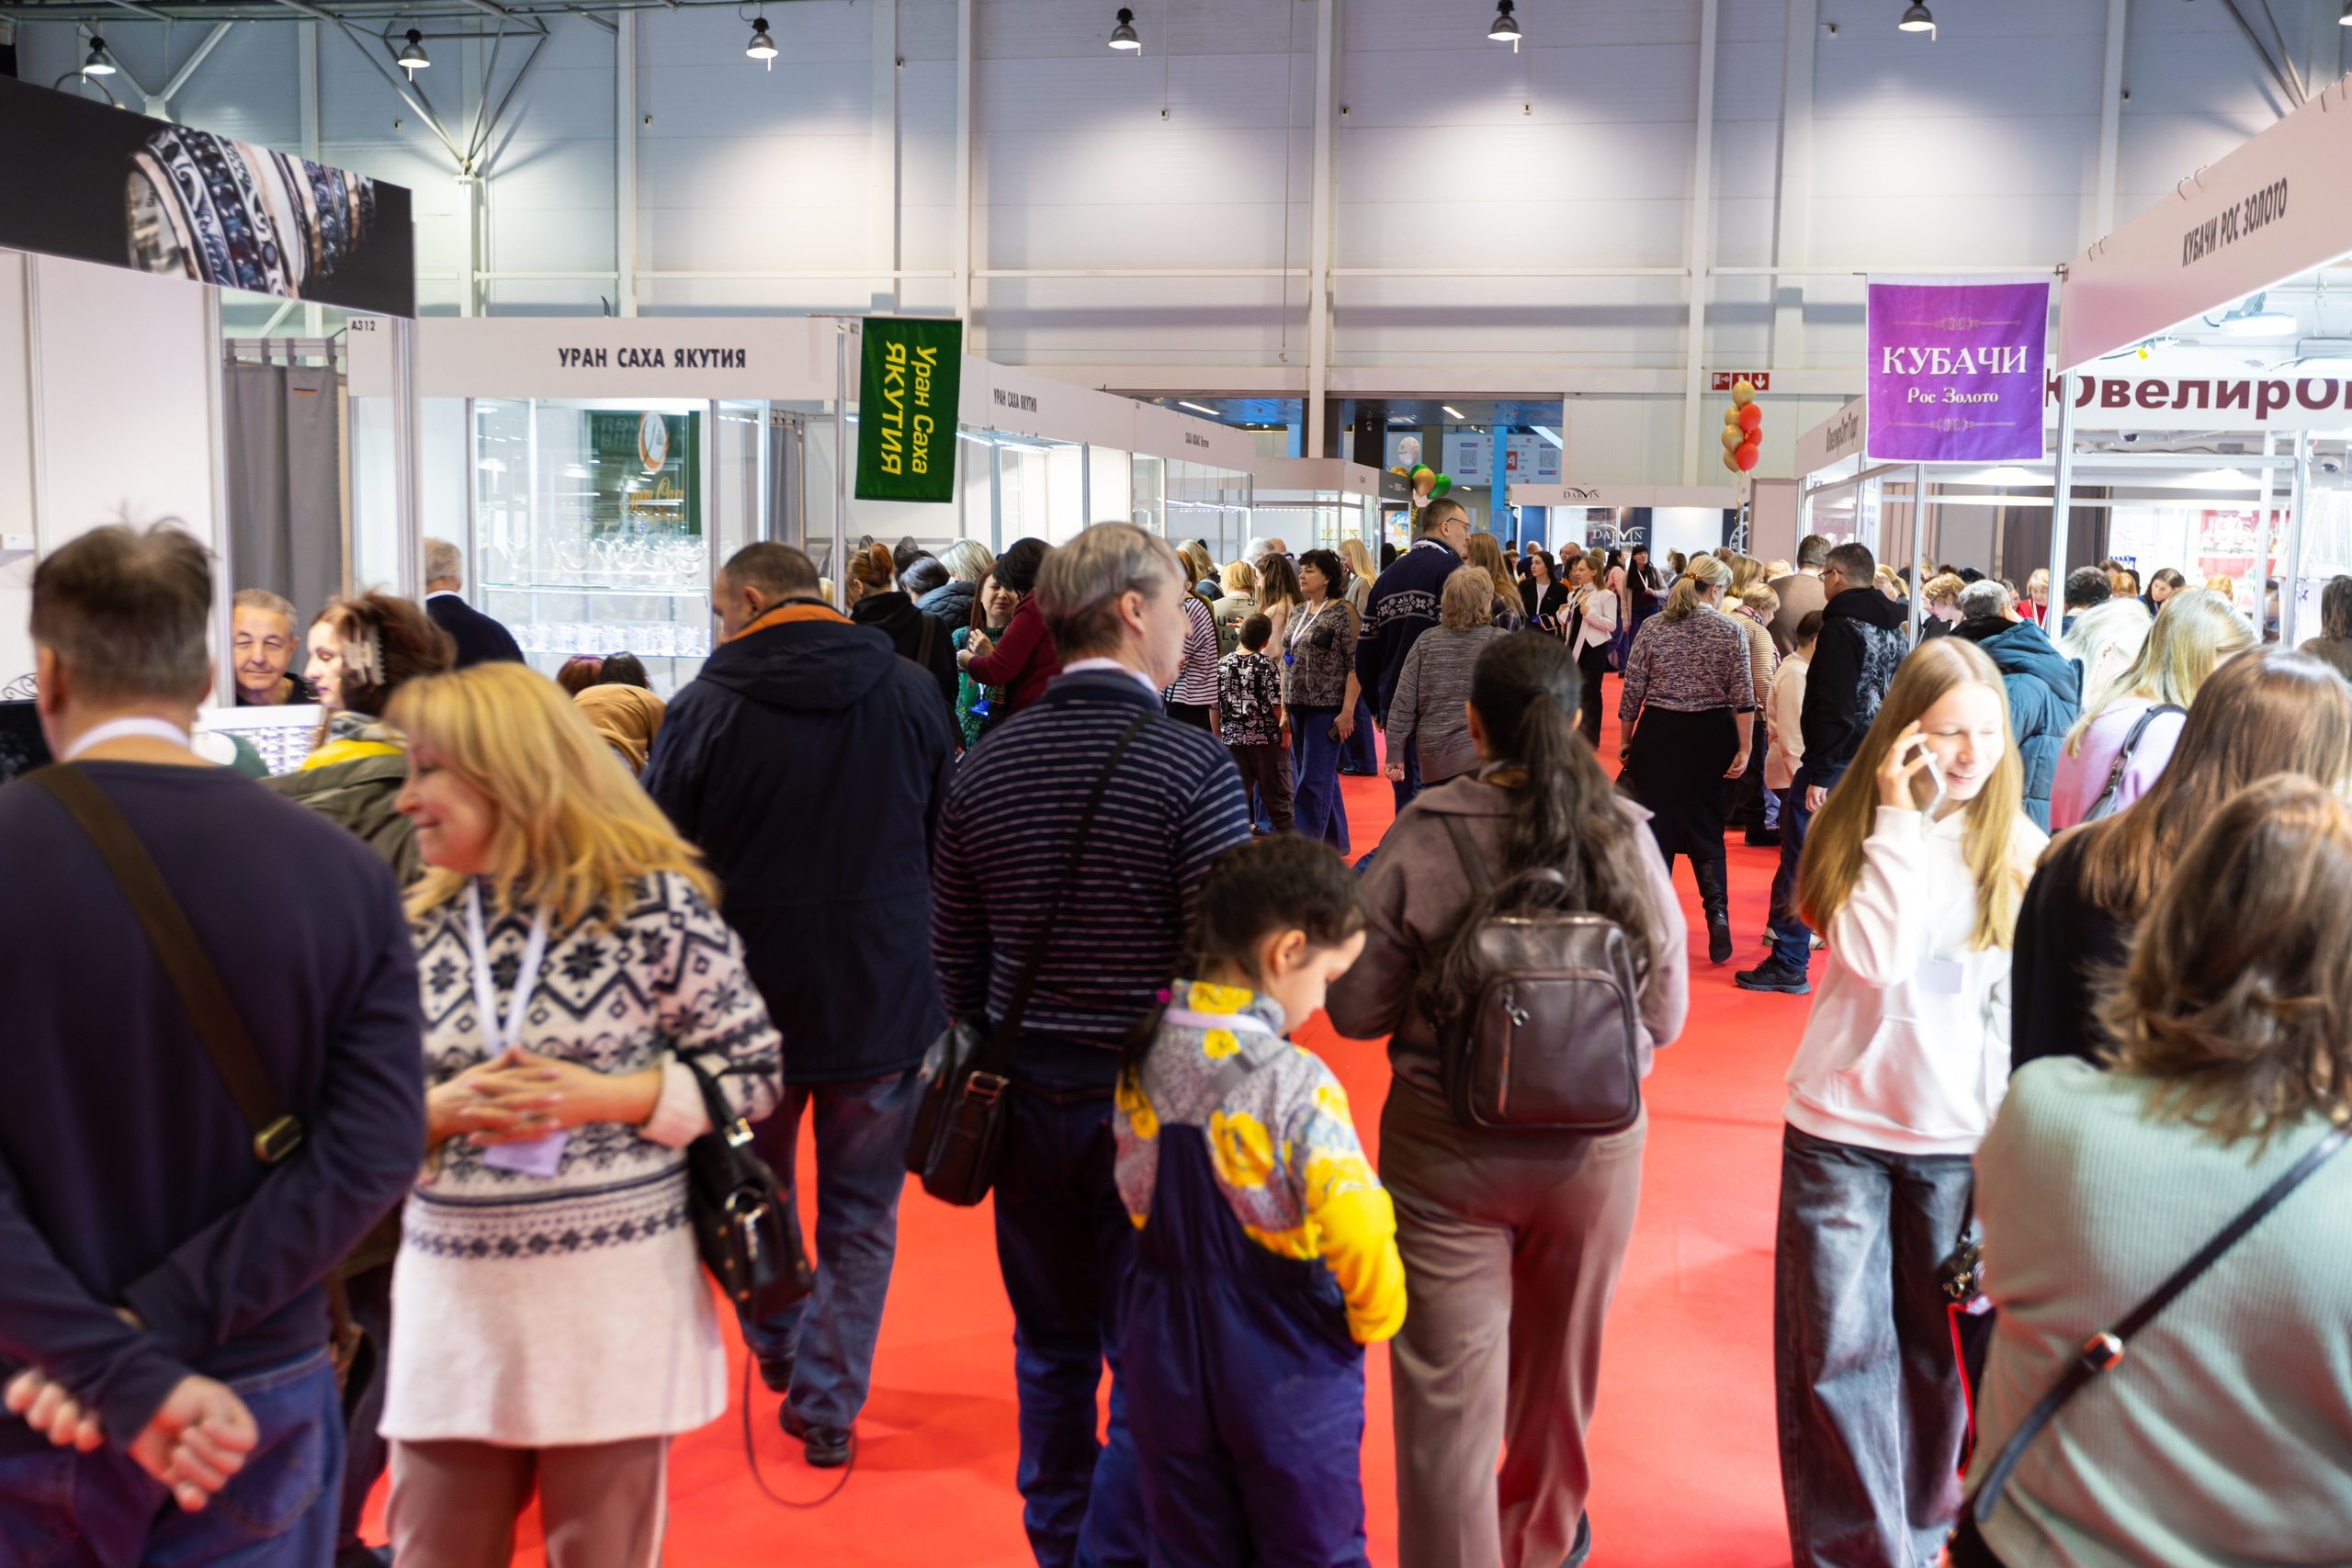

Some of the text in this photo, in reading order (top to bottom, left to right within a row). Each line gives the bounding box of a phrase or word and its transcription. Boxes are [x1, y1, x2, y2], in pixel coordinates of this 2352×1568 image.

[2182, 177, 2288, 267] КУБАЧИ РОС ЗОЛОТО
[351, 320, 376, 332] A312
[558, 347, 746, 368] УРАН САХА ЯКУТИЯ
[1882, 345, 2028, 376] КУБАЧИ
[993, 388, 1037, 413] УРАН САХА ЯКУТИЯ
[1907, 387, 1999, 405] Рос Золото
[2045, 368, 2352, 421] ЮвелирО
[880, 340, 907, 476] ЯКУТИЯ
[910, 345, 938, 475] Уран Саха
[1563, 488, 1600, 499] DARVIN
[1609, 539, 1643, 547] Jwelry
